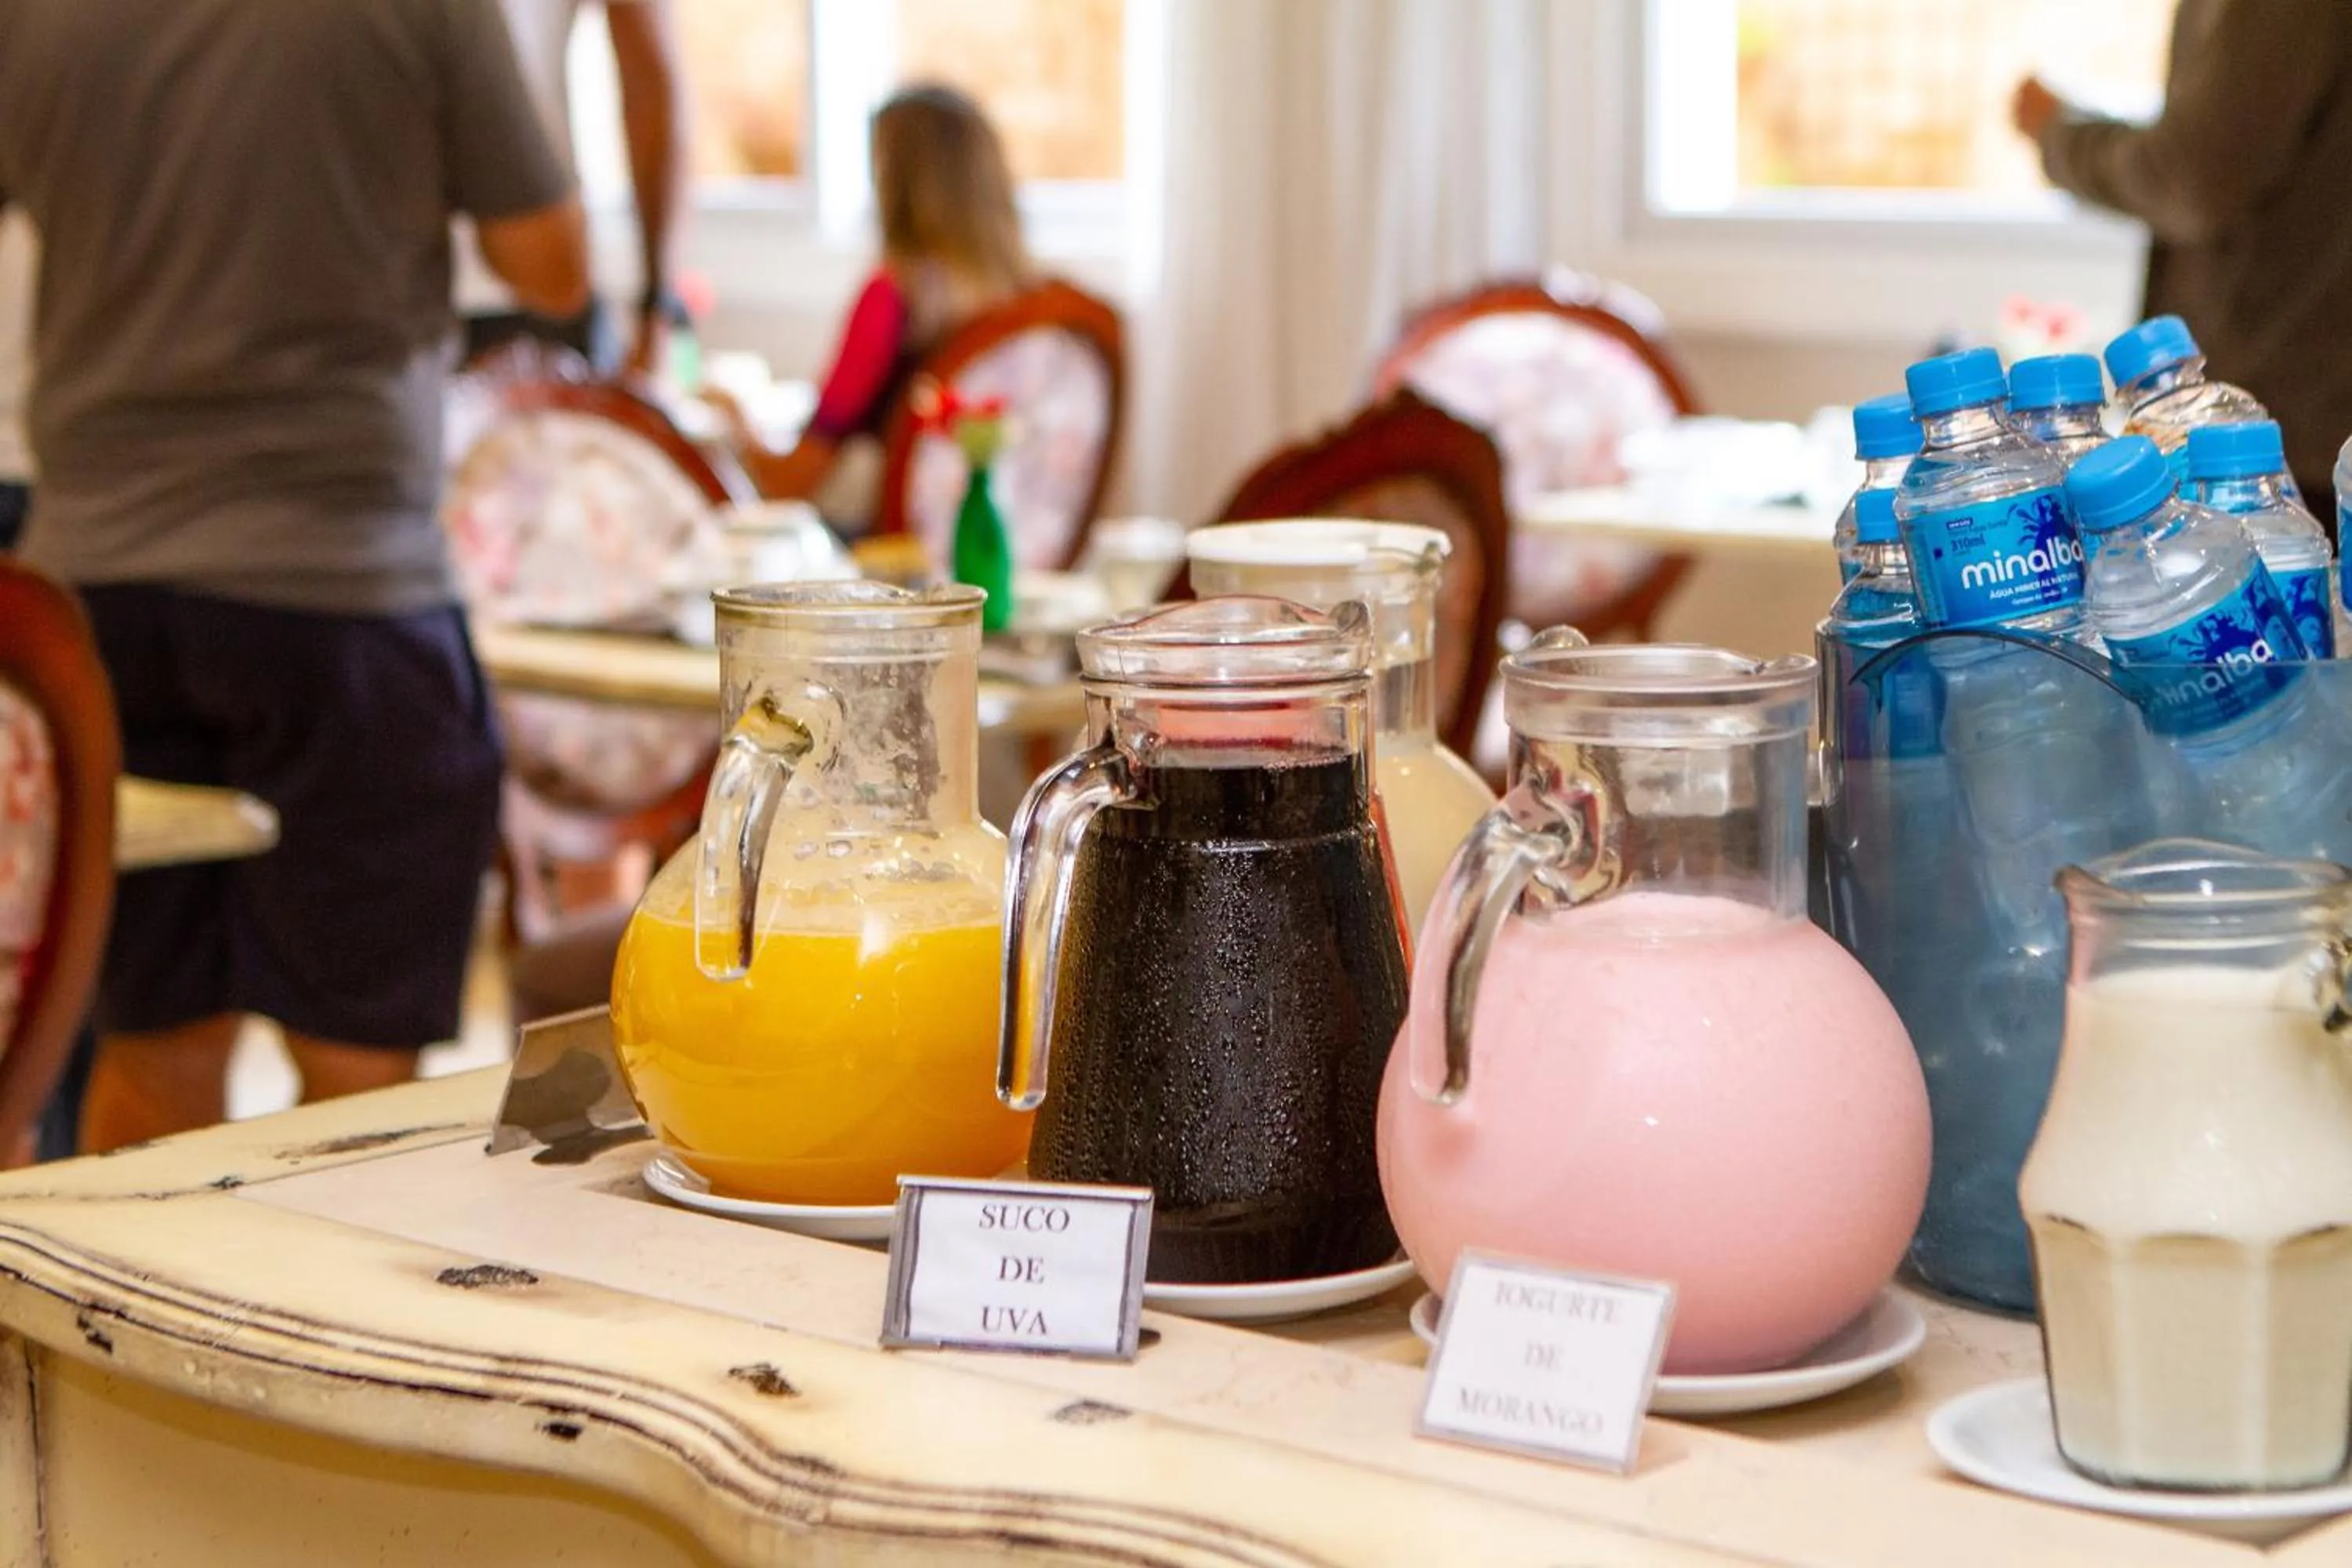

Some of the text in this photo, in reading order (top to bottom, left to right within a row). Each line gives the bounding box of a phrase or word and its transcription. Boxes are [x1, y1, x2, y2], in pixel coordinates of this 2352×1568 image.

[1962, 536, 2085, 589] minalba
[978, 1203, 1070, 1233] SUCO
[998, 1256, 1045, 1284] DE
[1494, 1279, 1620, 1325] IOGURTE
[981, 1306, 1047, 1336] UVA
[1523, 1338, 1563, 1373] DE
[1457, 1387, 1605, 1435] MORANGO
